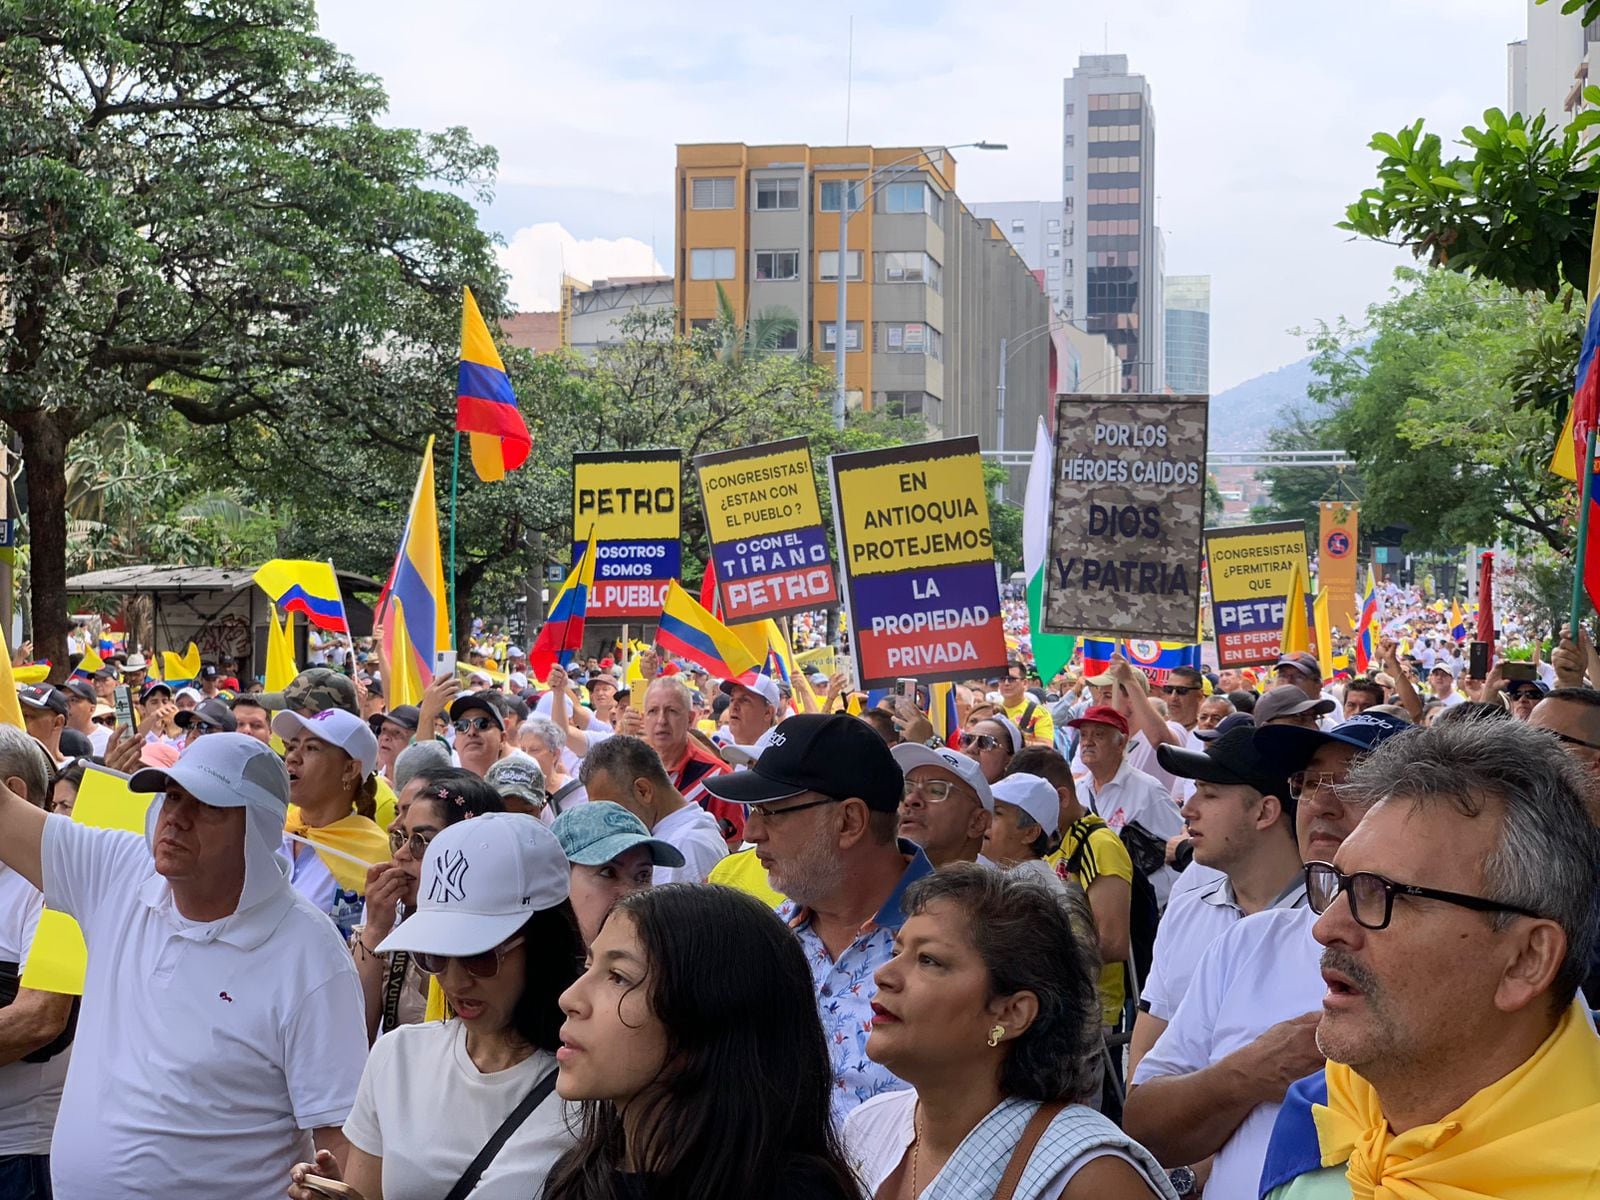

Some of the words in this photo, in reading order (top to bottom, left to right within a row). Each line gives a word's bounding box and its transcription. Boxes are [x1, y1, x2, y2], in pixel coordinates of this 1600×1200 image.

[1094, 424, 1130, 446] POR
[1133, 424, 1168, 448] LOS
[705, 461, 809, 494] ¡CONGRESISTAS!
[1061, 453, 1128, 482] HÉROES
[899, 471, 928, 493] EN
[579, 487, 675, 515] PETRO
[721, 489, 767, 511] ¿ESTAN
[769, 484, 798, 499] CON
[726, 514, 741, 527] EL
[743, 505, 792, 524] PUEBLO
[864, 498, 979, 530] ANTIOQUIA
[1088, 504, 1160, 539] DIOS
[736, 543, 747, 555] O
[750, 537, 782, 552] CON
[784, 533, 803, 546] EL
[853, 528, 992, 562] PROTEJEMOS
[1213, 543, 1304, 563] ¡CONGRESISTAS!
[602, 563, 652, 576] SOMOS
[723, 544, 826, 577] TIRANO
[728, 570, 830, 609] PETRO
[912, 578, 941, 600] LA
[1056, 558, 1076, 590] Y
[1082, 559, 1189, 596] PATRIA
[1249, 579, 1272, 591] QUE
[872, 606, 990, 637] PROPIEDAD
[1220, 602, 1307, 627] PETR
[1225, 634, 1241, 646] SE
[888, 641, 978, 668] PRIVADA
[1224, 650, 1242, 661] EN
[1245, 648, 1260, 659] EL
[392, 951, 407, 973] UIS
[385, 977, 402, 1028] VUITTO
